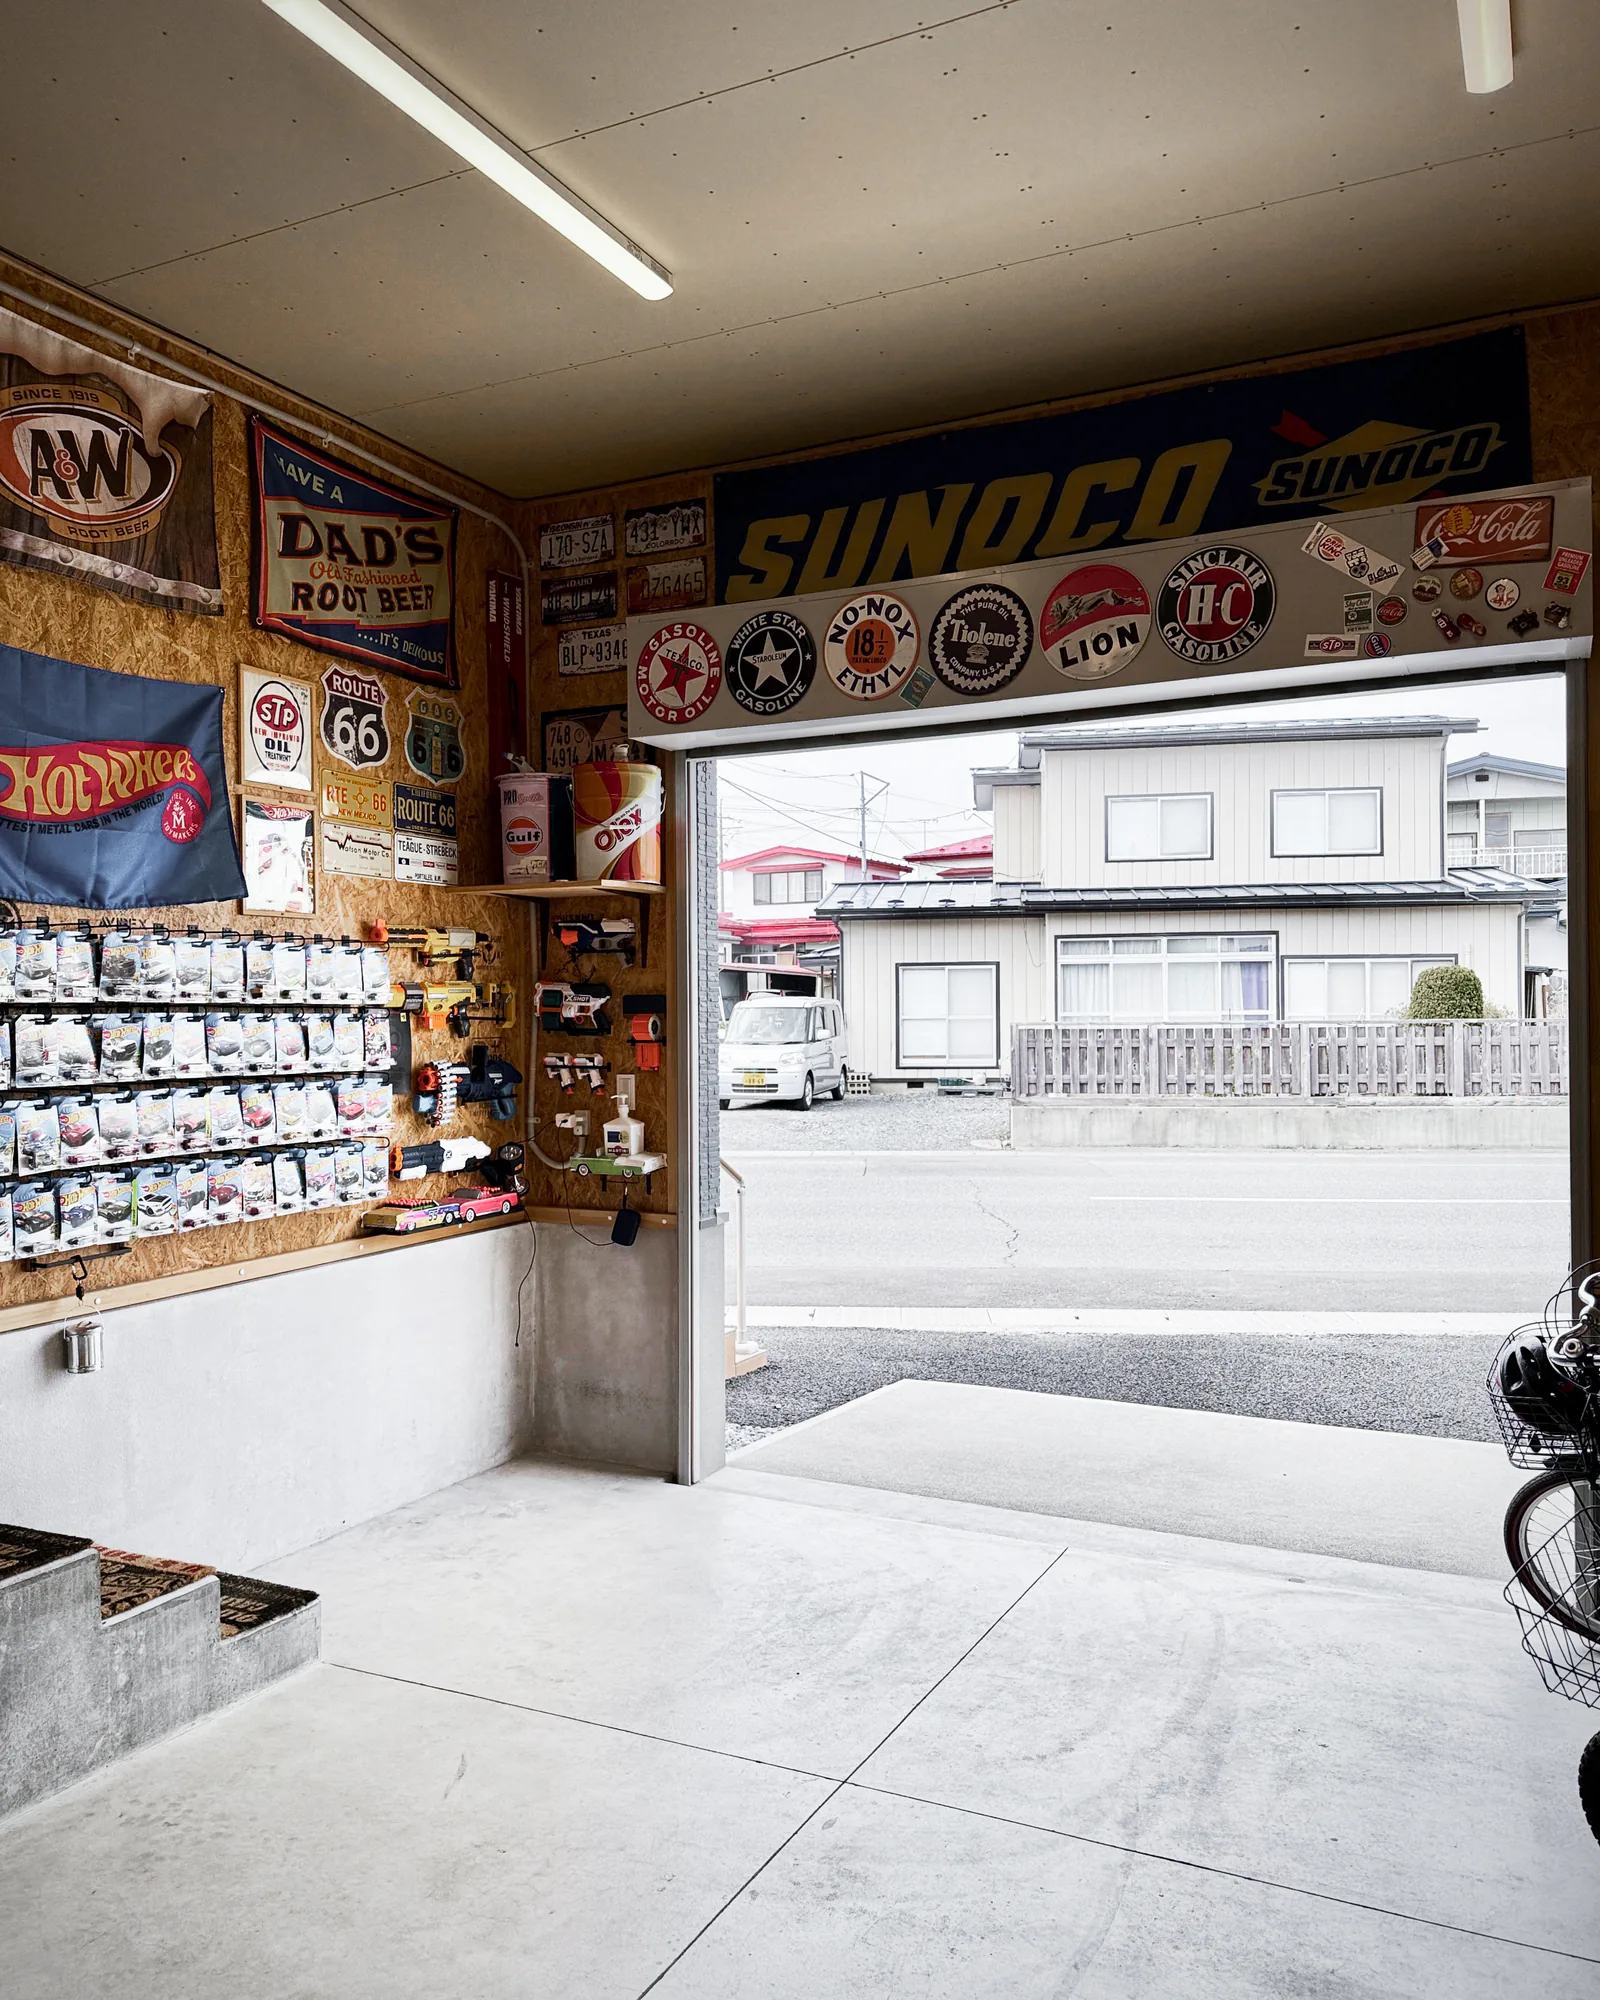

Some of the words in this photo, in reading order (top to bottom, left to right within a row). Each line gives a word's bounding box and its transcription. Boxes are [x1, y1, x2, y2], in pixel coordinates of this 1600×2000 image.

[12, 388, 62, 402] SINCE
[68, 389, 99, 403] 1919
[29, 426, 134, 503] A&W
[1264, 426, 1494, 502] SUNOCO
[330, 485, 344, 504] A
[68, 525, 109, 540] ROOT
[116, 519, 150, 536] BEER
[724, 437, 1233, 606] SUNOCO
[1420, 501, 1549, 546] C-Cola
[1453, 508, 1463, 533] SHELL
[277, 512, 445, 568] DAD'S
[1319, 542, 1343, 558] KING
[1325, 537, 1347, 551] DRIFT
[309, 561, 342, 580] Old
[343, 566, 422, 586] Fashioned
[1168, 549, 1268, 592] SINCLAIR
[1556, 575, 1570, 585] 93
[291, 581, 368, 613] ROOT
[376, 584, 435, 613] BEER
[488, 580, 497, 623] YAKIMA
[960, 604, 977, 616] THE
[977, 601, 999, 612] PURE
[998, 609, 1011, 621] OIL
[1185, 582, 1247, 626] H-C
[502, 597, 511, 663] WINDSHIELD
[582, 628, 611, 640] TEXAS
[731, 613, 767, 650] WHITE
[772, 612, 807, 640] STAR
[828, 597, 915, 645] NO-NOX
[949, 618, 1016, 648] Tiolene
[402, 640, 446, 665] DELICOUS
[648, 624, 720, 679] GASOLINE
[853, 628, 875, 656] 18
[1059, 621, 1140, 668] LION
[1162, 620, 1264, 662] GASOLINE
[1322, 639, 1342, 651] STP
[1370, 635, 1385, 655] Gulf
[665, 648, 703, 671] TEXACO
[332, 673, 380, 703] ROUTE
[671, 663, 689, 687] T
[836, 663, 907, 694] ETHYL
[637, 665, 678, 722] MOTOR
[684, 695, 713, 719] OIL
[735, 679, 807, 713] GASOLINE
[260, 697, 295, 727] STP
[419, 700, 454, 720] GAS
[264, 737, 291, 754] OIL
[333, 707, 380, 757] 66
[264, 750, 292, 762] TREATMENT
[327, 785, 348, 805] RTE
[372, 792, 387, 813] 66
[503, 789, 517, 805] PRO
[38, 824, 72, 834] METAL
[74, 819, 100, 833] CARS
[100, 814, 112, 826] IN
[111, 808, 134, 822] THE
[338, 808, 352, 817] NEW
[353, 810, 377, 821] MEXICO
[397, 796, 437, 826] ROUTE
[439, 805, 455, 829] 66
[163, 821, 199, 840] TOYMAKERS
[506, 830, 541, 843] Gulf
[338, 843, 362, 855] Watson
[363, 847, 380, 858] Motor
